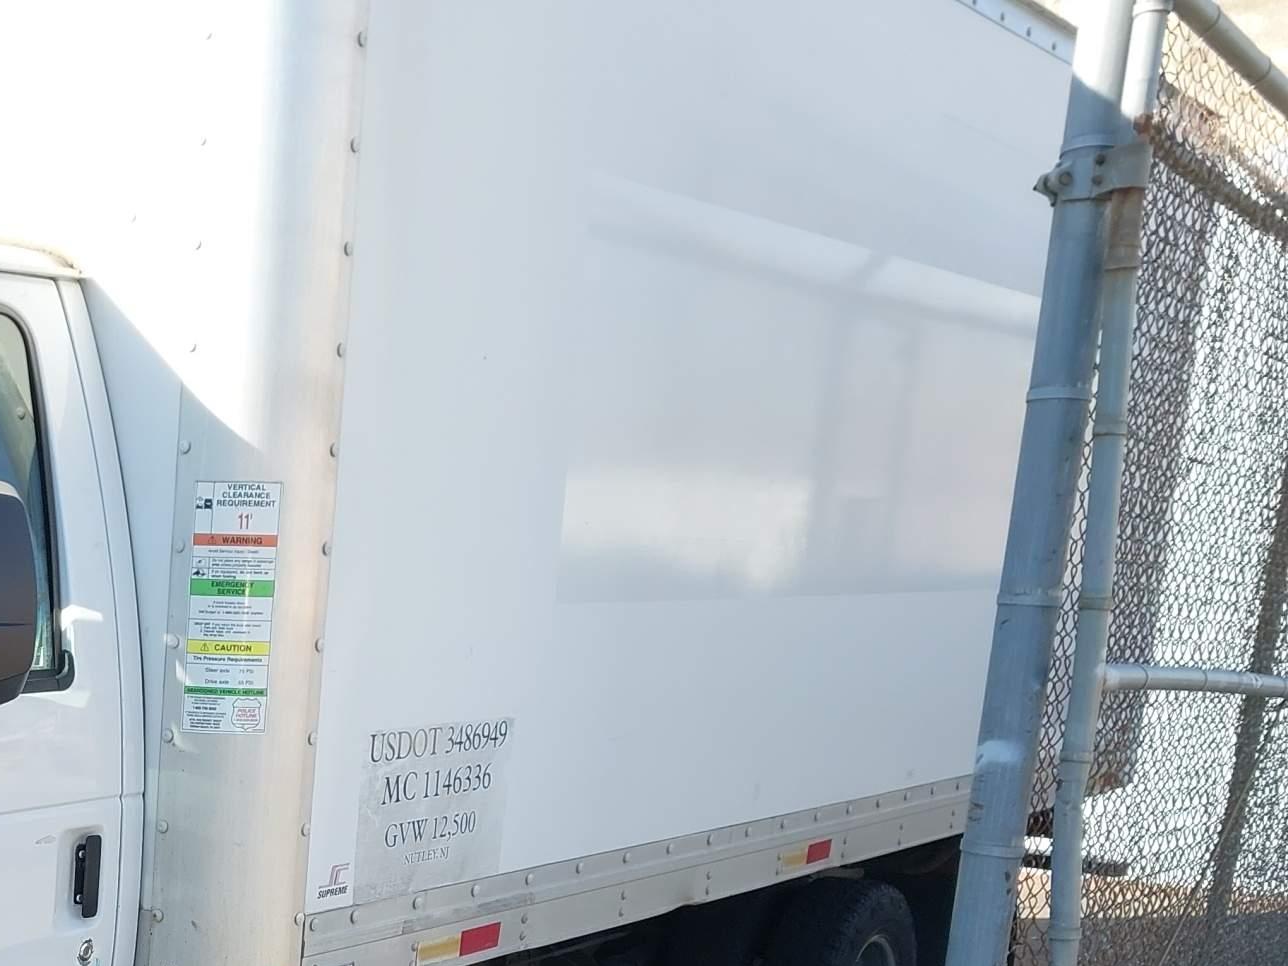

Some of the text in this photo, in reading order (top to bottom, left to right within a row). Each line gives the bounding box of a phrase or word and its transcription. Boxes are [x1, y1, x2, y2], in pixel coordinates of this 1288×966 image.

[216, 499, 276, 508] REQUIREMENT
[222, 537, 262, 545] WARNING
[214, 644, 252, 653] CAUTION
[370, 720, 508, 763] USDOT 3486949
[381, 762, 493, 806] MC 1146336
[384, 810, 476, 848] GVW 12,500
[317, 885, 348, 899] SUPREME
